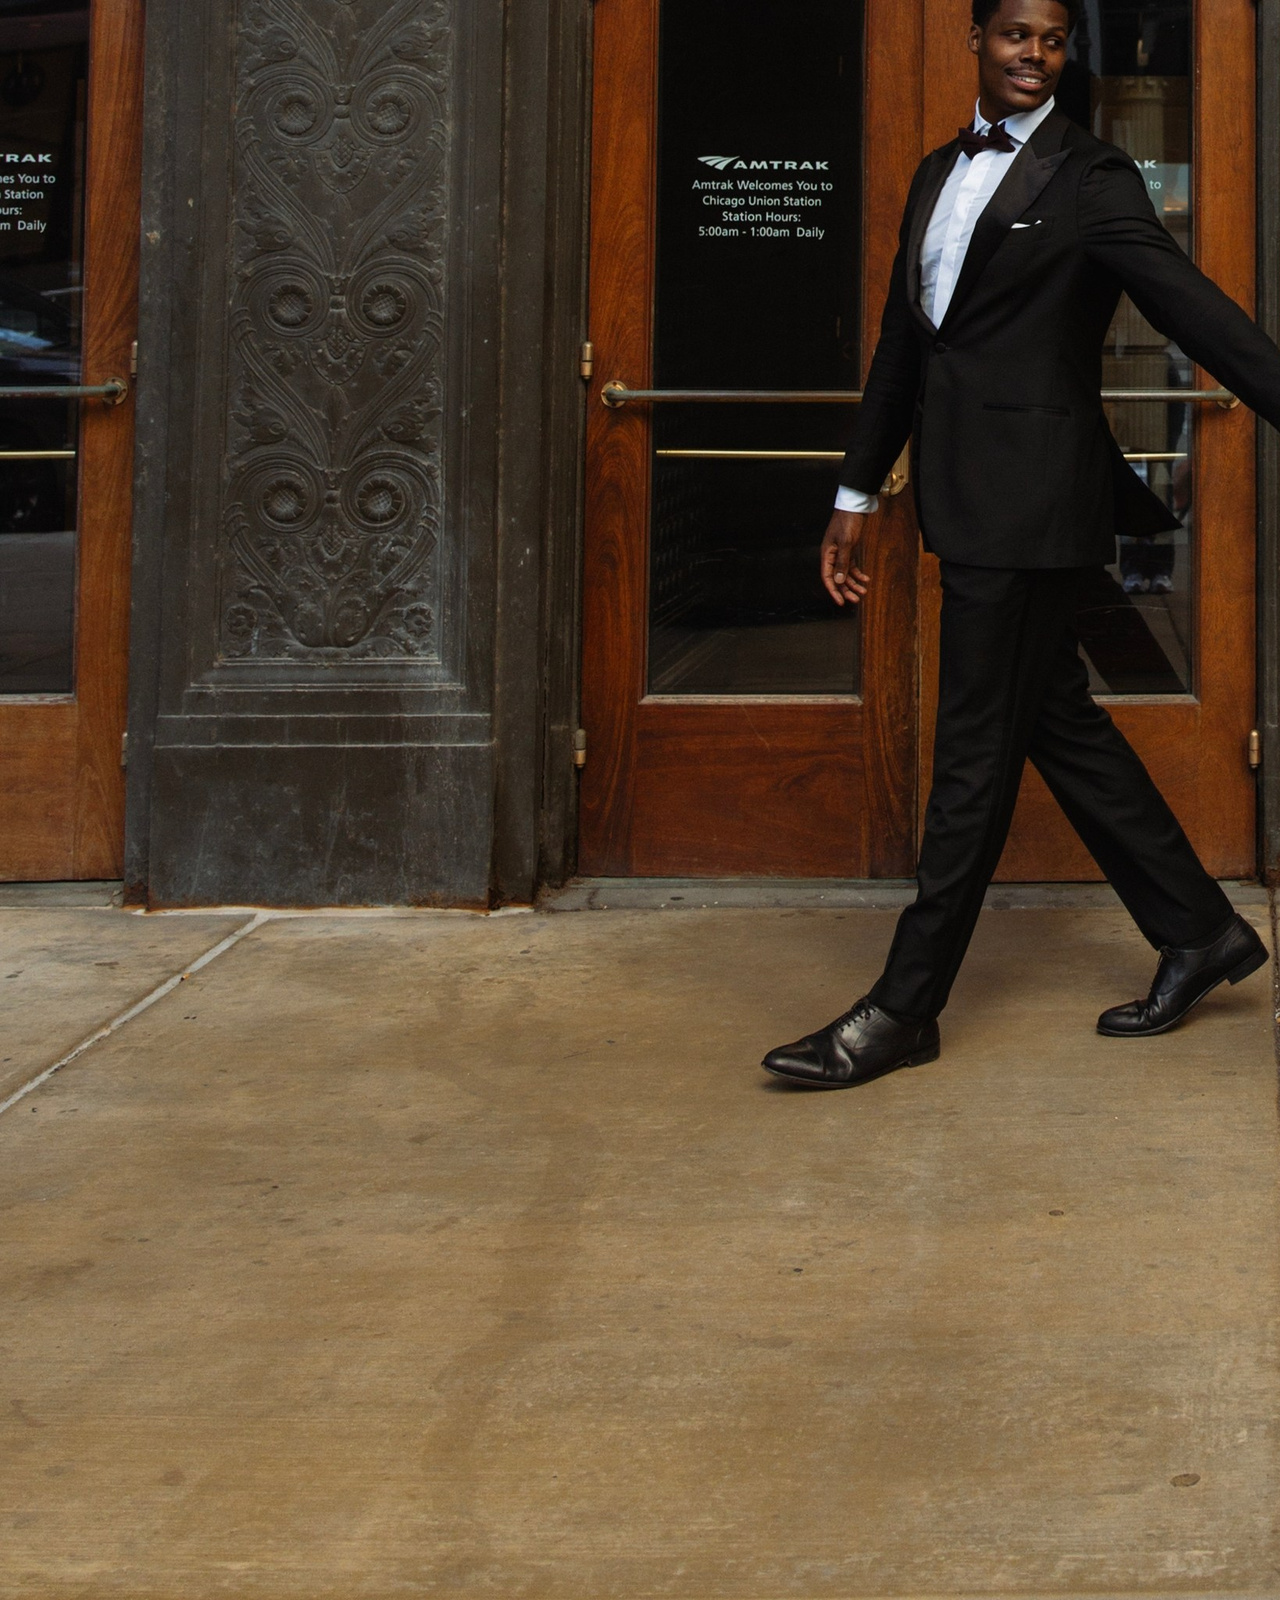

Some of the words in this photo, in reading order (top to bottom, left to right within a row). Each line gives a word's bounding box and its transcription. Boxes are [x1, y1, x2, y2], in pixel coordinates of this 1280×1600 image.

[733, 160, 830, 171] AMTRAK
[0, 175, 15, 184] es
[17, 173, 40, 184] You
[42, 174, 56, 184] to
[1149, 180, 1162, 190] to
[691, 179, 734, 191] Amtrak
[736, 179, 794, 191] Welcomes
[795, 180, 818, 192] You
[820, 181, 834, 192] to
[4, 189, 44, 200] Station
[702, 195, 746, 209] Chicago
[748, 195, 781, 207] Union
[783, 195, 822, 207] Station
[722, 210, 763, 222] Station
[765, 211, 802, 223] Hours:
[17, 219, 47, 234] Daily
[698, 225, 739, 237] 5:00am
[750, 226, 791, 238] 1:00am
[796, 226, 826, 241] Daily
